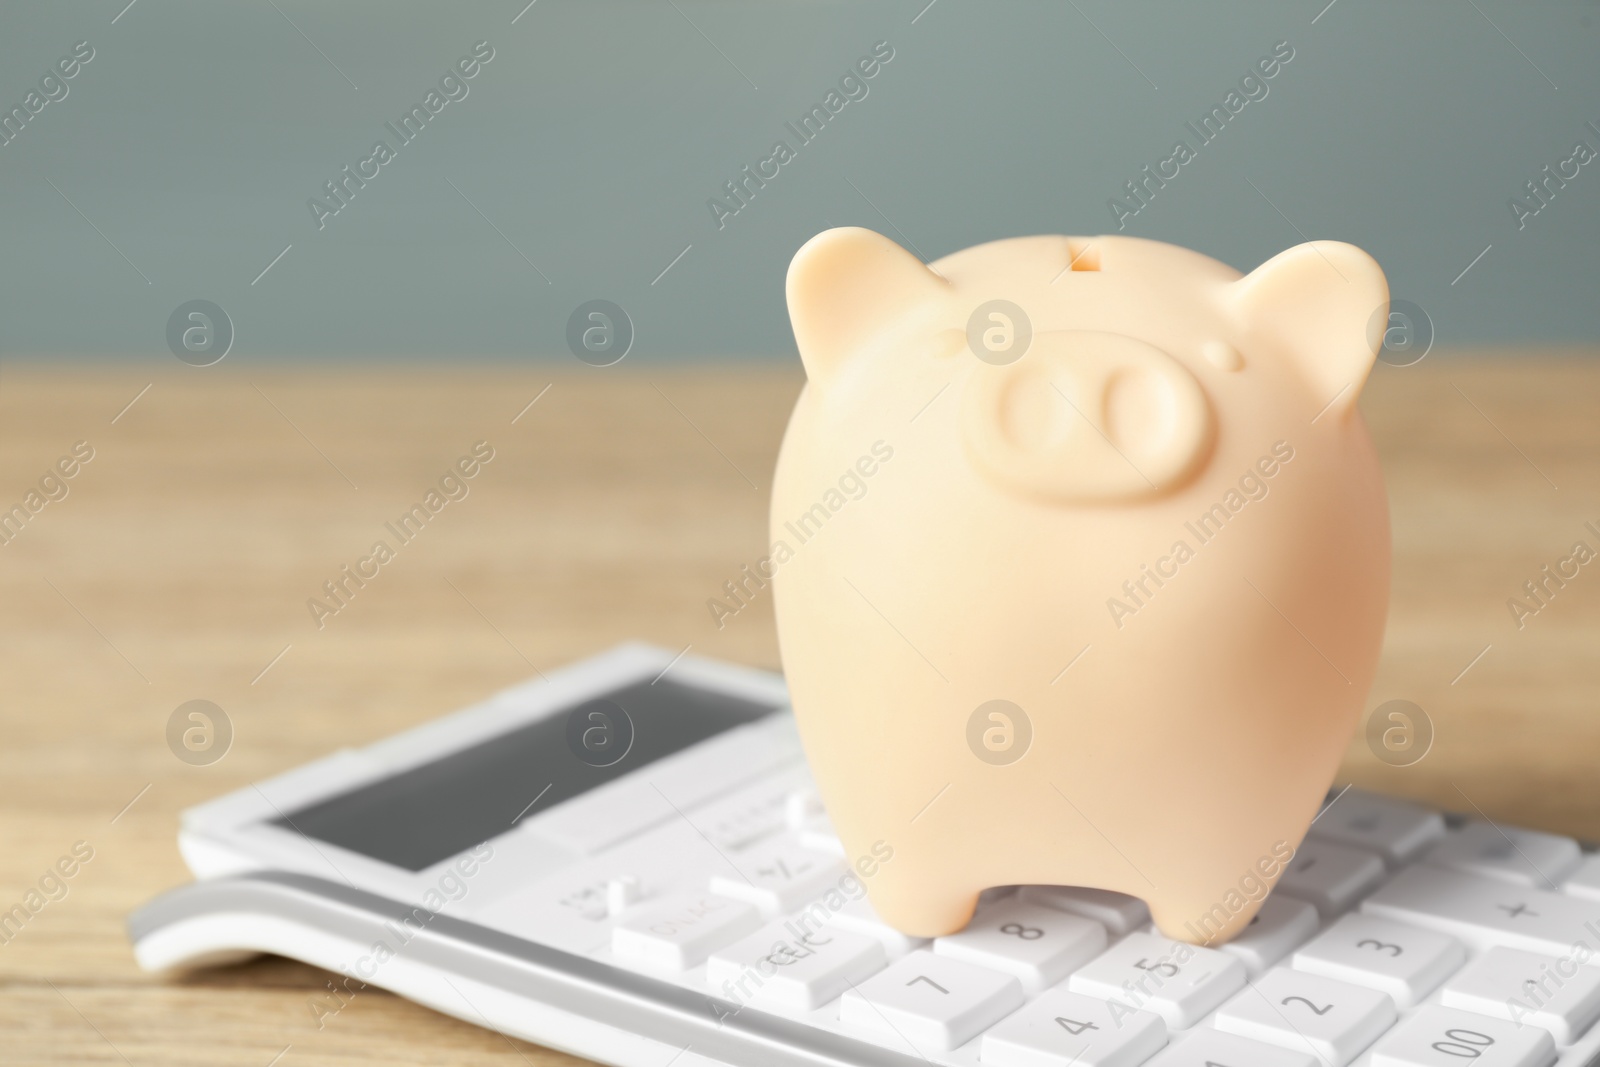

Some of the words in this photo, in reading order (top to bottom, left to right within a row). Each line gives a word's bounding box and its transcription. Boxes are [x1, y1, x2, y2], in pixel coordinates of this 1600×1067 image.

[1000, 922, 1045, 941] 8
[1356, 938, 1403, 958] 3
[1133, 957, 1180, 978] 5
[905, 975, 950, 995] 7
[1281, 996, 1334, 1016] 2
[1054, 1015, 1099, 1036] 4
[1431, 1028, 1495, 1058] 00
